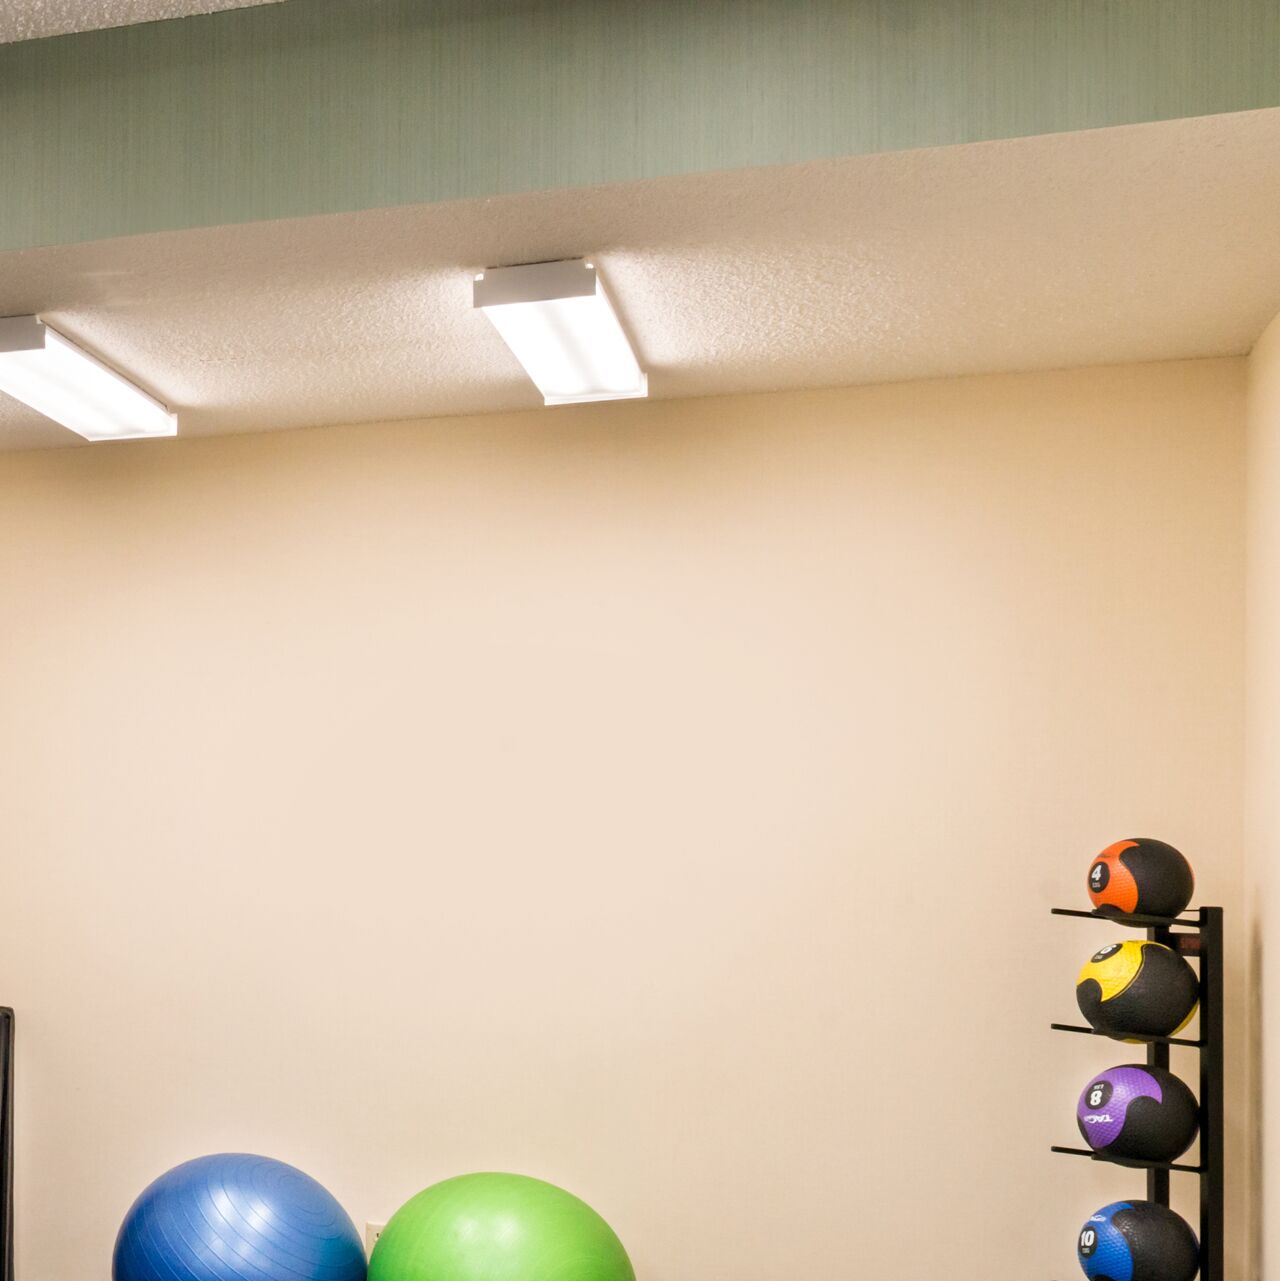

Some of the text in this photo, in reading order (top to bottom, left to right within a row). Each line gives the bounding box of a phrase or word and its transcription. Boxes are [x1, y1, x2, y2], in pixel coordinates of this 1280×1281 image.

[1091, 864, 1102, 881] 4
[1090, 1090, 1103, 1106] 8
[1081, 1230, 1095, 1247] 10
